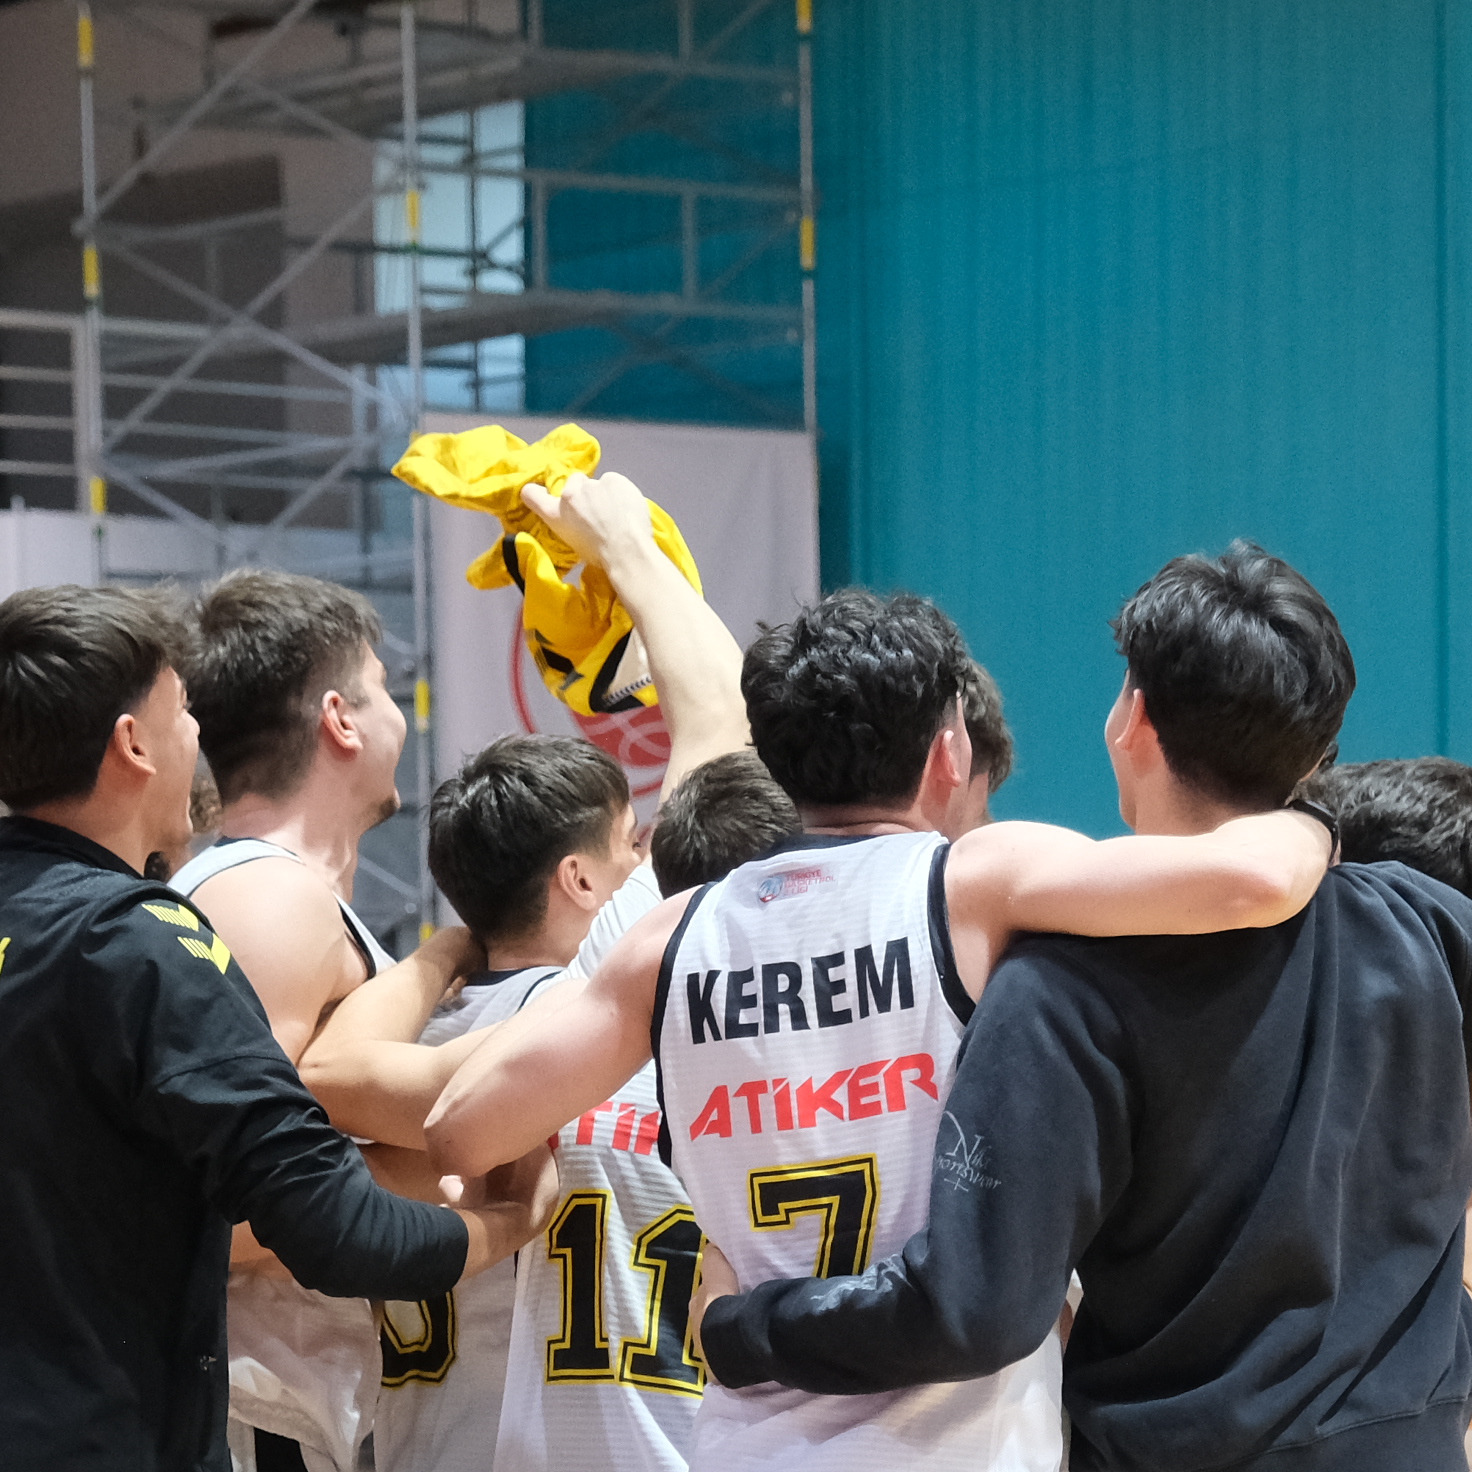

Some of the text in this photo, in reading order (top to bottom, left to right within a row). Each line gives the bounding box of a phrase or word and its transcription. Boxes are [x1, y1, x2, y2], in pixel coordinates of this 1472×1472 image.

[686, 936, 915, 1045] KEREM
[747, 1153, 881, 1281] 7
[544, 1187, 707, 1400] 11
